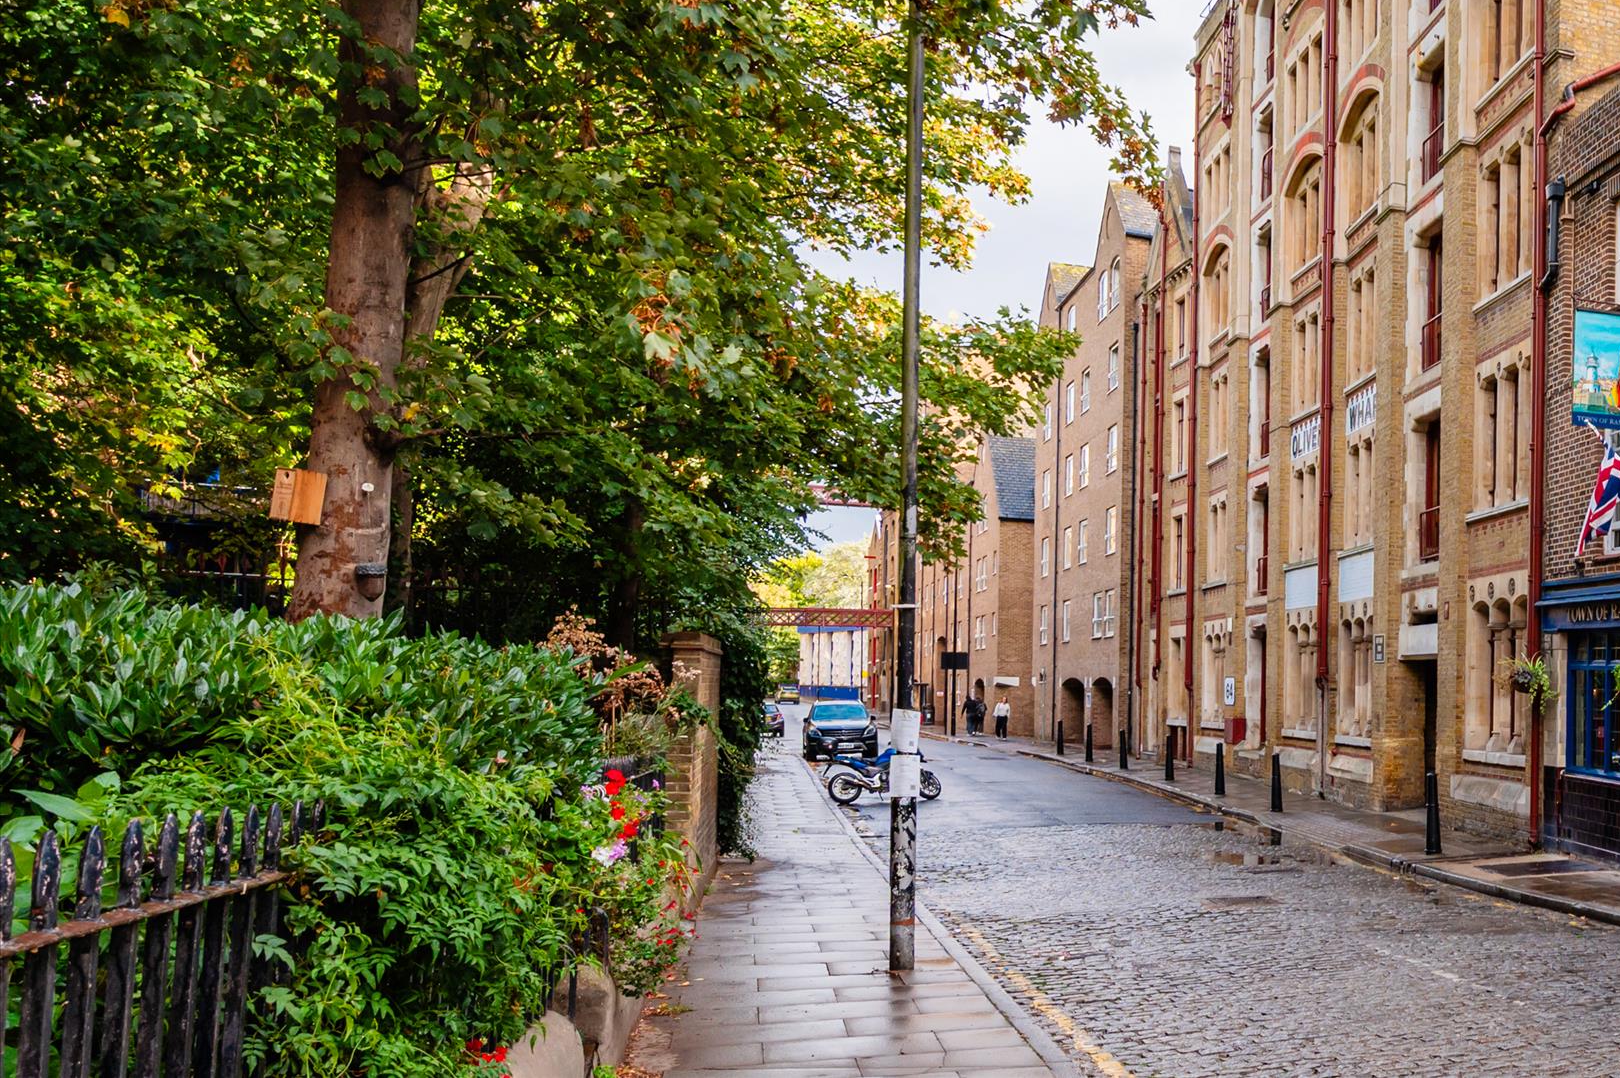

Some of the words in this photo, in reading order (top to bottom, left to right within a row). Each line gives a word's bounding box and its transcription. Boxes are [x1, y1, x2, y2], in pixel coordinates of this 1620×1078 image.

[1599, 417, 1608, 425] OF
[1292, 424, 1321, 459] OLIVE
[1567, 606, 1593, 623] TOWN
[1596, 605, 1608, 621] OF
